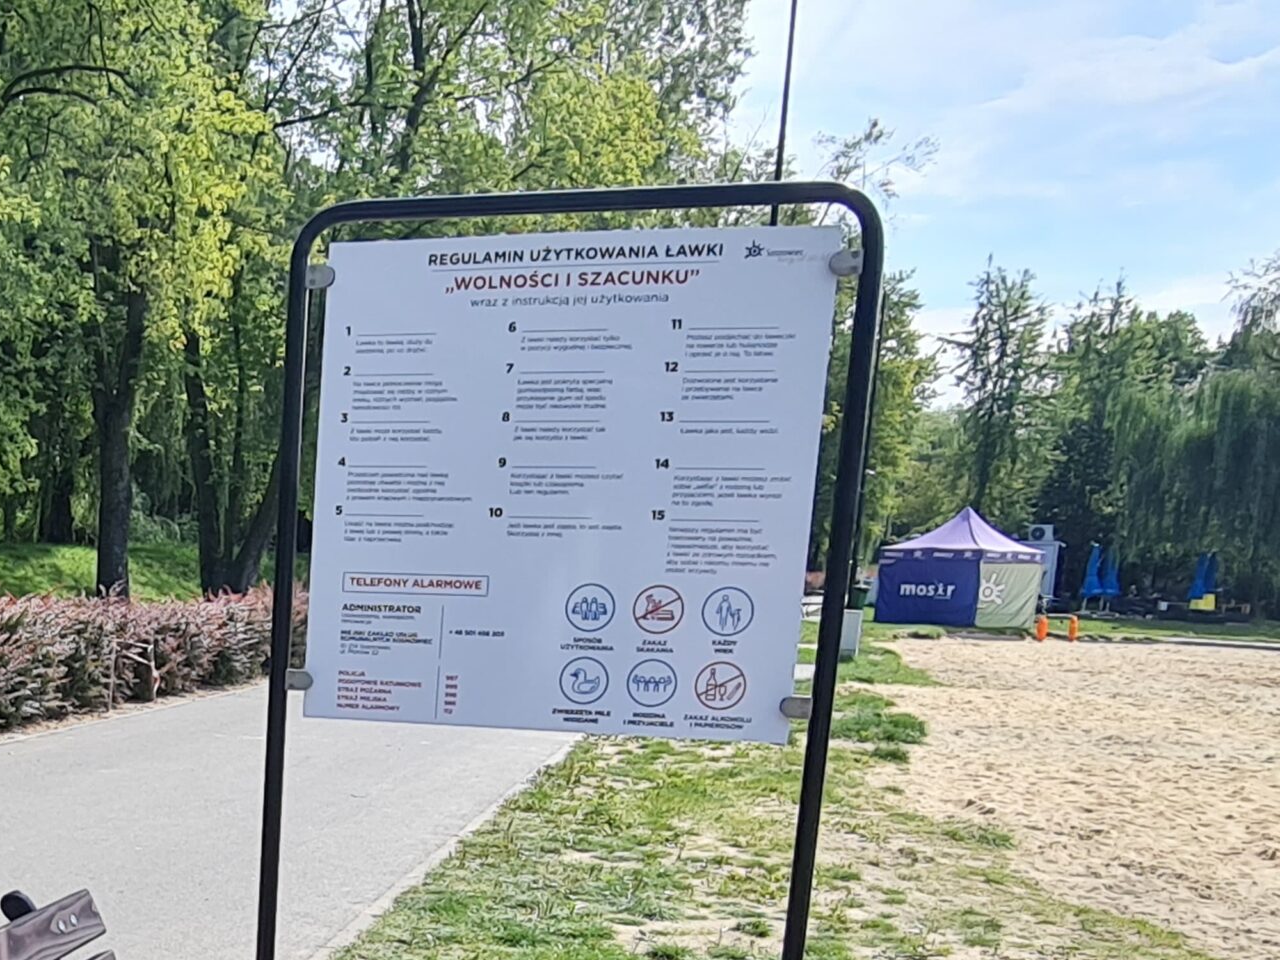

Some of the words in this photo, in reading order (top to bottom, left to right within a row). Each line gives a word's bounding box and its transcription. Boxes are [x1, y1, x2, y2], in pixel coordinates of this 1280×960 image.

[428, 249, 524, 266] REGULAMIN
[530, 245, 659, 263] UŻYTKOWANIA
[665, 243, 724, 258] ŁAWKI
[565, 272, 572, 287] I
[470, 298, 498, 307] wraz
[501, 298, 509, 307] z
[511, 295, 570, 307] instrukcją
[572, 295, 587, 306] jej
[590, 293, 670, 306] użytkowania
[508, 321, 517, 333] 6
[671, 318, 683, 330] 11
[345, 326, 352, 336] 1
[343, 366, 352, 376] 2
[505, 363, 515, 374] 7
[664, 361, 679, 373] 12
[340, 412, 349, 423] 3
[501, 411, 510, 423] 8
[659, 411, 674, 422] 13
[337, 456, 346, 467] 4
[498, 457, 507, 468] 9
[654, 458, 670, 469] 14
[335, 505, 343, 516] 5
[488, 507, 503, 518] 10
[651, 509, 666, 521] 15
[349, 576, 409, 588] TELEFONY
[412, 579, 483, 590] ALARMOWE
[899, 582, 956, 598] mosir
[341, 603, 422, 614] ADMINISTRATOR
